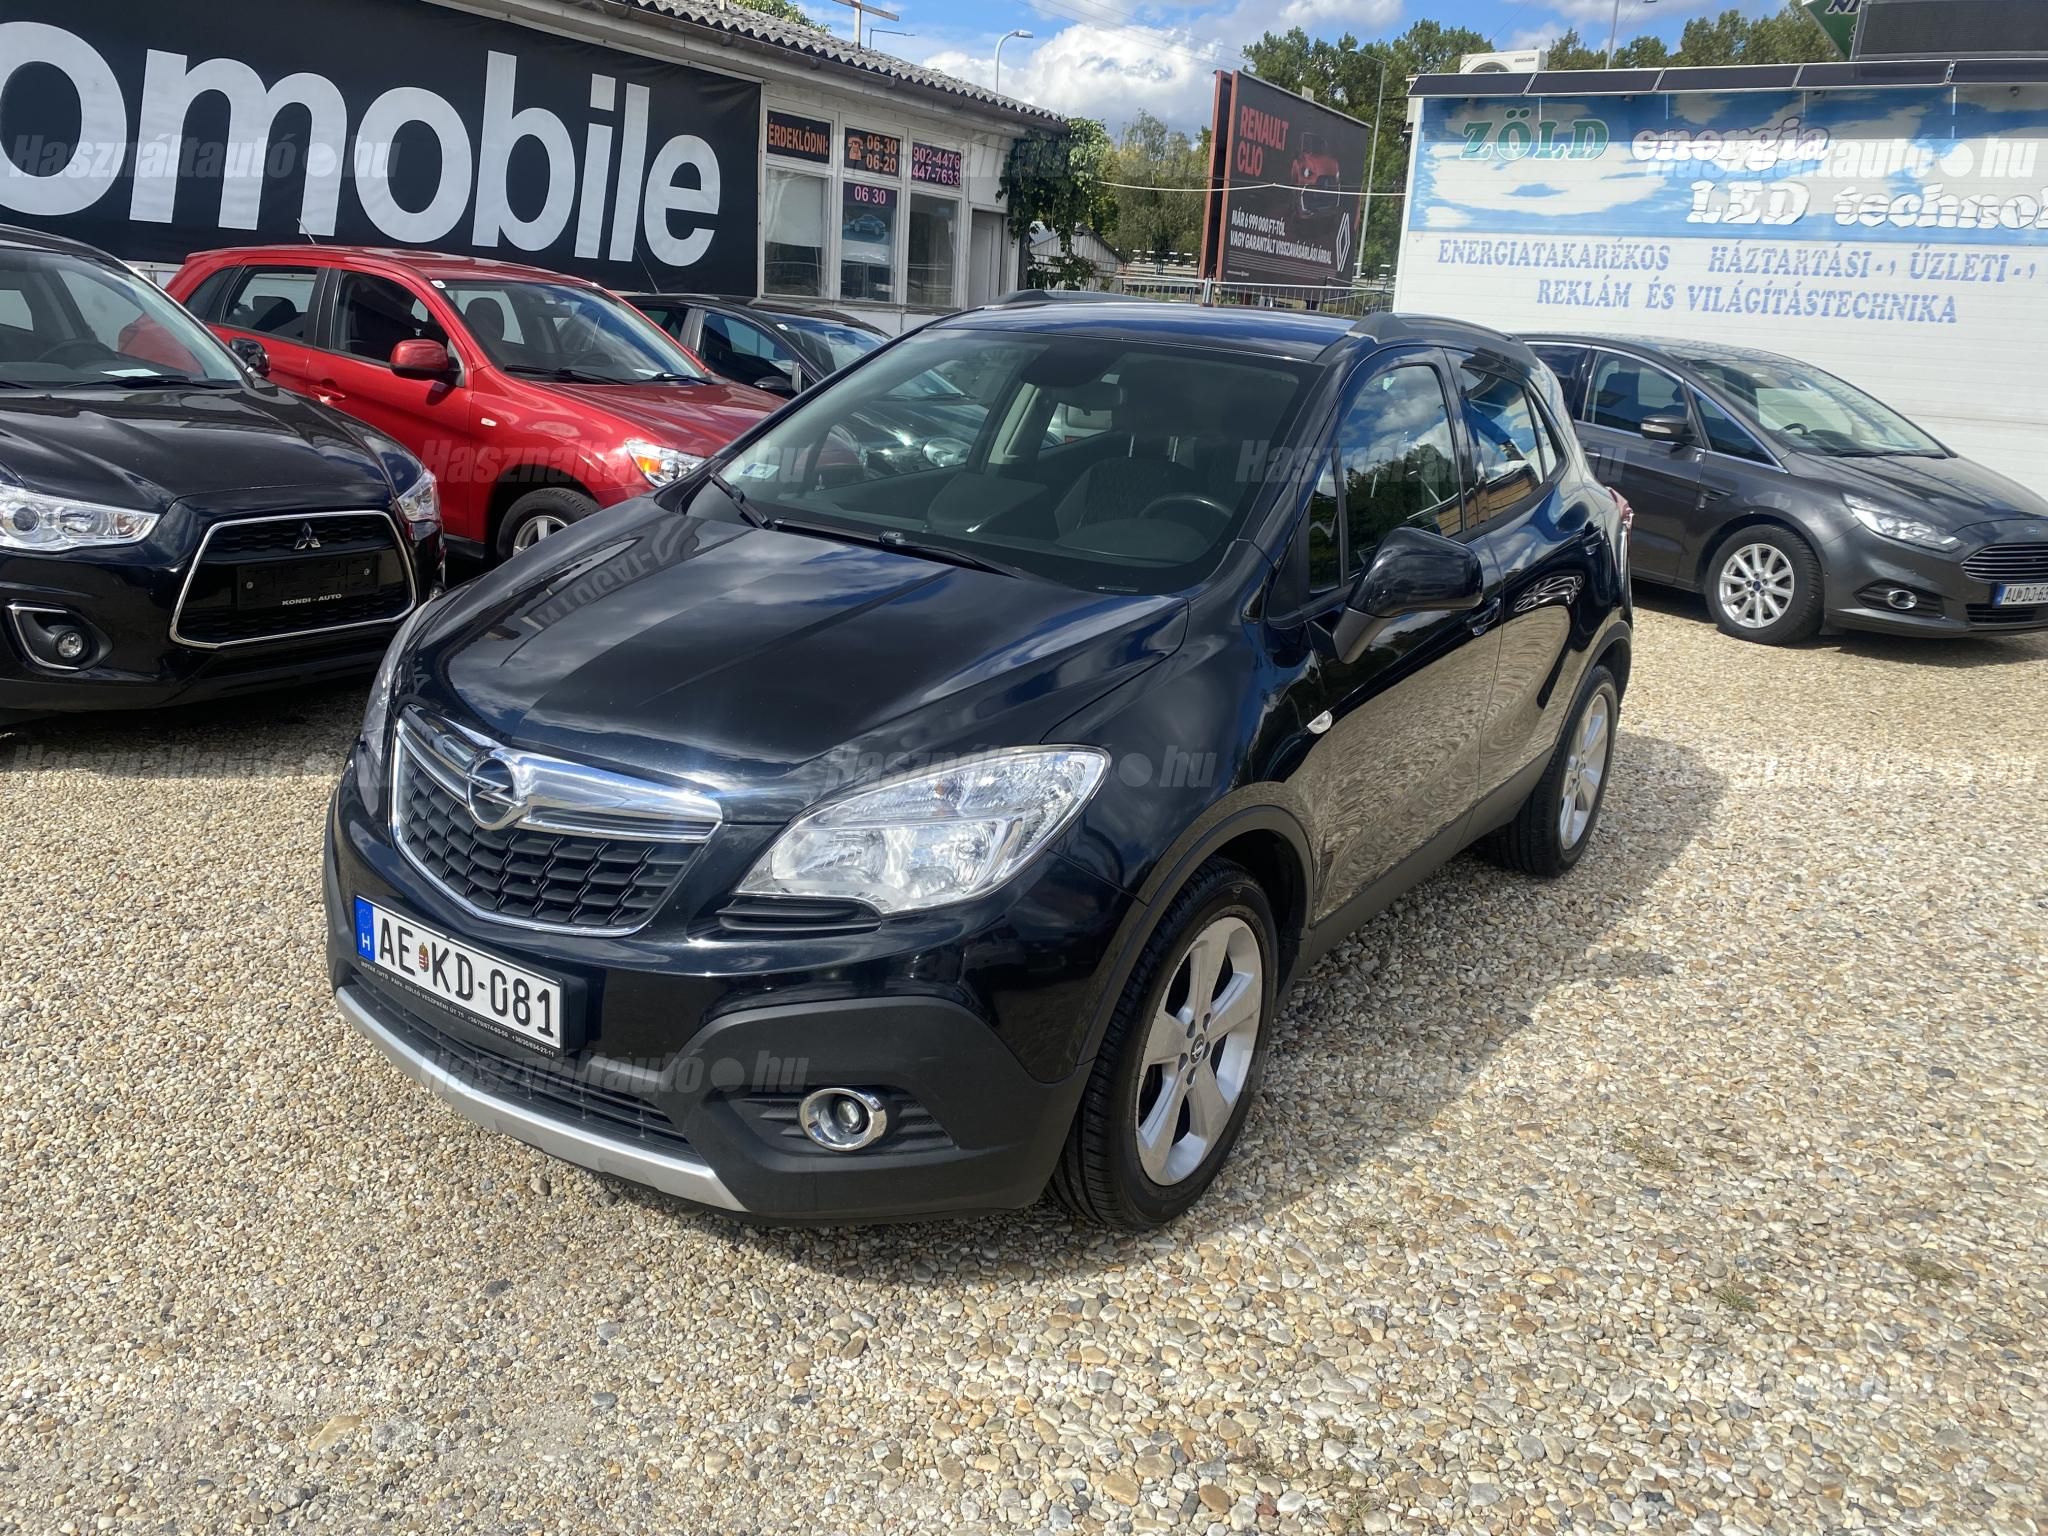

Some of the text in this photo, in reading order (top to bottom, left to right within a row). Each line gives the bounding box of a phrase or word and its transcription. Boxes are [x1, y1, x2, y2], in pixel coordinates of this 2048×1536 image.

[768, 117, 829, 156] ÉRDEKLŐDNI:
[1240, 105, 1288, 151] RENAULT
[1459, 108, 1832, 171] ZÖLD energia
[0, 21, 721, 267] omobile
[866, 135, 897, 154] 06-30
[866, 153, 897, 172] 06-20
[912, 147, 961, 169] 902-4476
[1237, 140, 1263, 177] CLIO
[912, 166, 961, 185] 447-7633
[854, 185, 887, 205] 06 30
[1686, 180, 1811, 226] LED
[1231, 206, 1245, 227] MÁR
[1230, 230, 1246, 248] VAGY
[1245, 234, 1276, 253] GARANTÁLT
[1437, 237, 1671, 272] ENERGIATAKARÉKOS
[1537, 274, 1958, 324] REKLÁM ÉS VILÁGÍTÁSTECHNIKA
[281, 597, 311, 606] KONDI
[318, 593, 342, 602] AUTO
[2021, 586, 2048, 602] DJ-6
[361, 932, 371, 951] H
[379, 917, 554, 1038] AE KD-081
